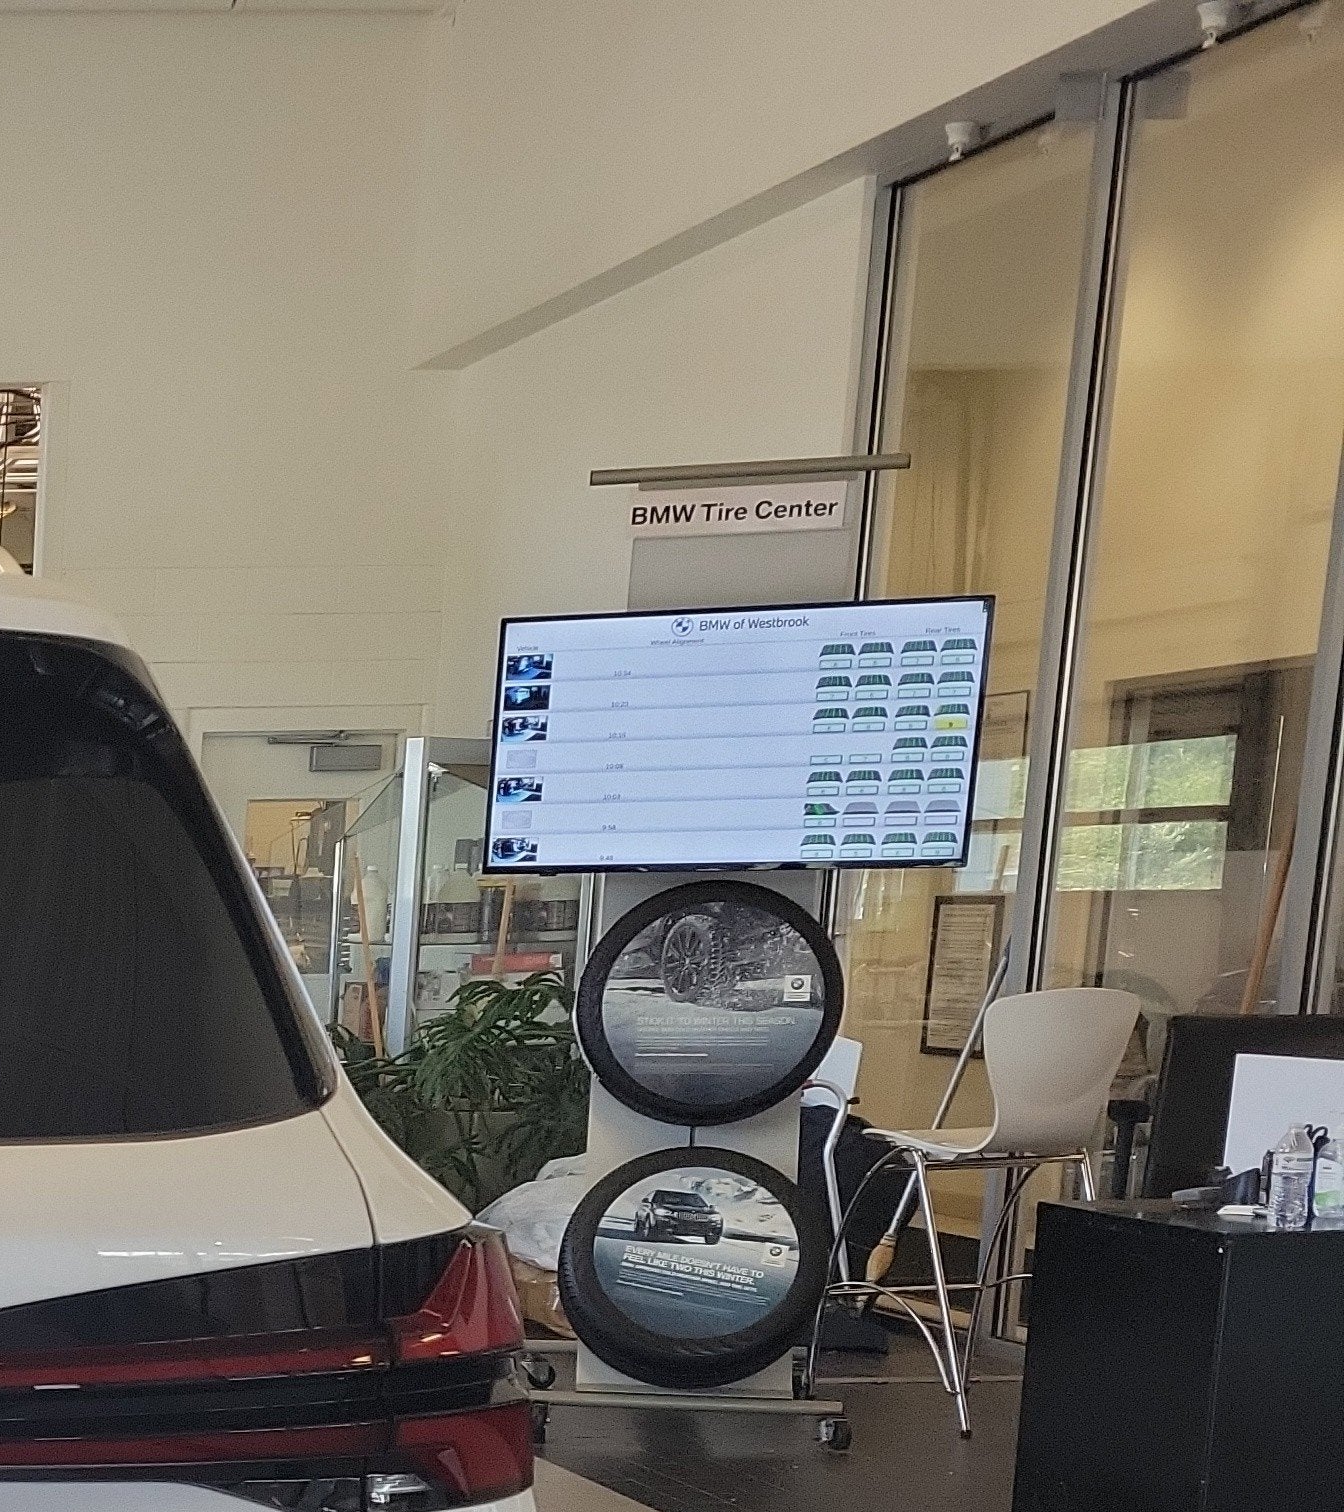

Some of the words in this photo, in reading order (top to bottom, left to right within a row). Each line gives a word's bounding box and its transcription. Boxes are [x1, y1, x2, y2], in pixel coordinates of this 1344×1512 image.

[631, 503, 696, 525] BMW
[701, 502, 748, 522] Tire
[755, 499, 839, 520] Center
[699, 619, 731, 631] BMW
[733, 618, 745, 630] of
[748, 616, 810, 629] Westbrook
[624, 1252, 646, 1264] FEEL
[648, 1257, 668, 1268] LIKE
[671, 1261, 692, 1273] TWO
[694, 1265, 715, 1278] THIS
[626, 1245, 656, 1258] EVERY
[657, 1251, 679, 1262] MILE
[681, 1254, 722, 1270] DOESN'T
[723, 1263, 750, 1275] HAVE
[752, 1269, 765, 1279] TO
